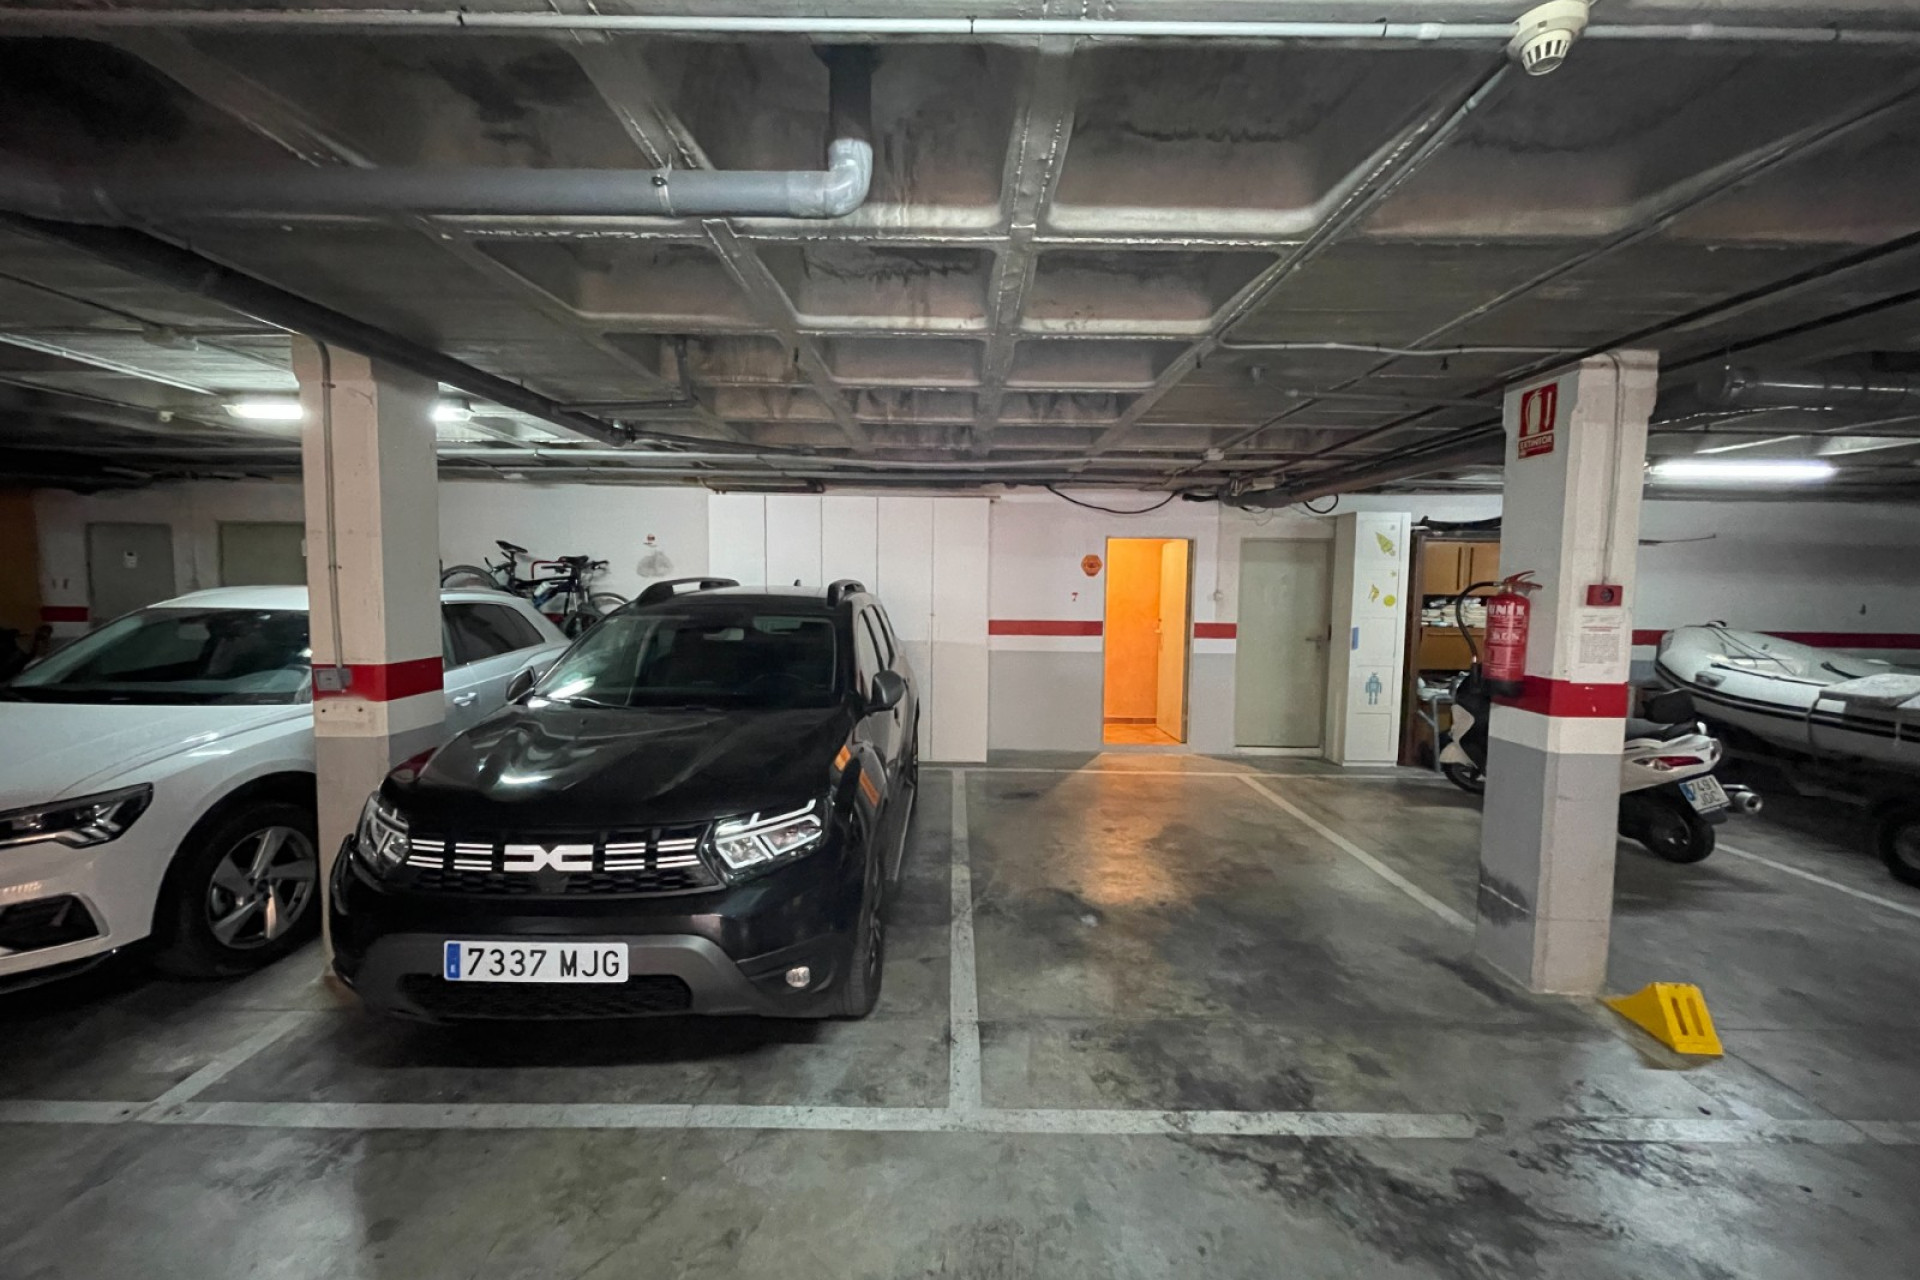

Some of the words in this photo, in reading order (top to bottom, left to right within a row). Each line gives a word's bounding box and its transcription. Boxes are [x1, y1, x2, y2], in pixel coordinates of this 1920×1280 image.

[1519, 434, 1553, 450] EXTINTOR
[467, 947, 547, 977] 7337
[560, 950, 620, 977] MJG
